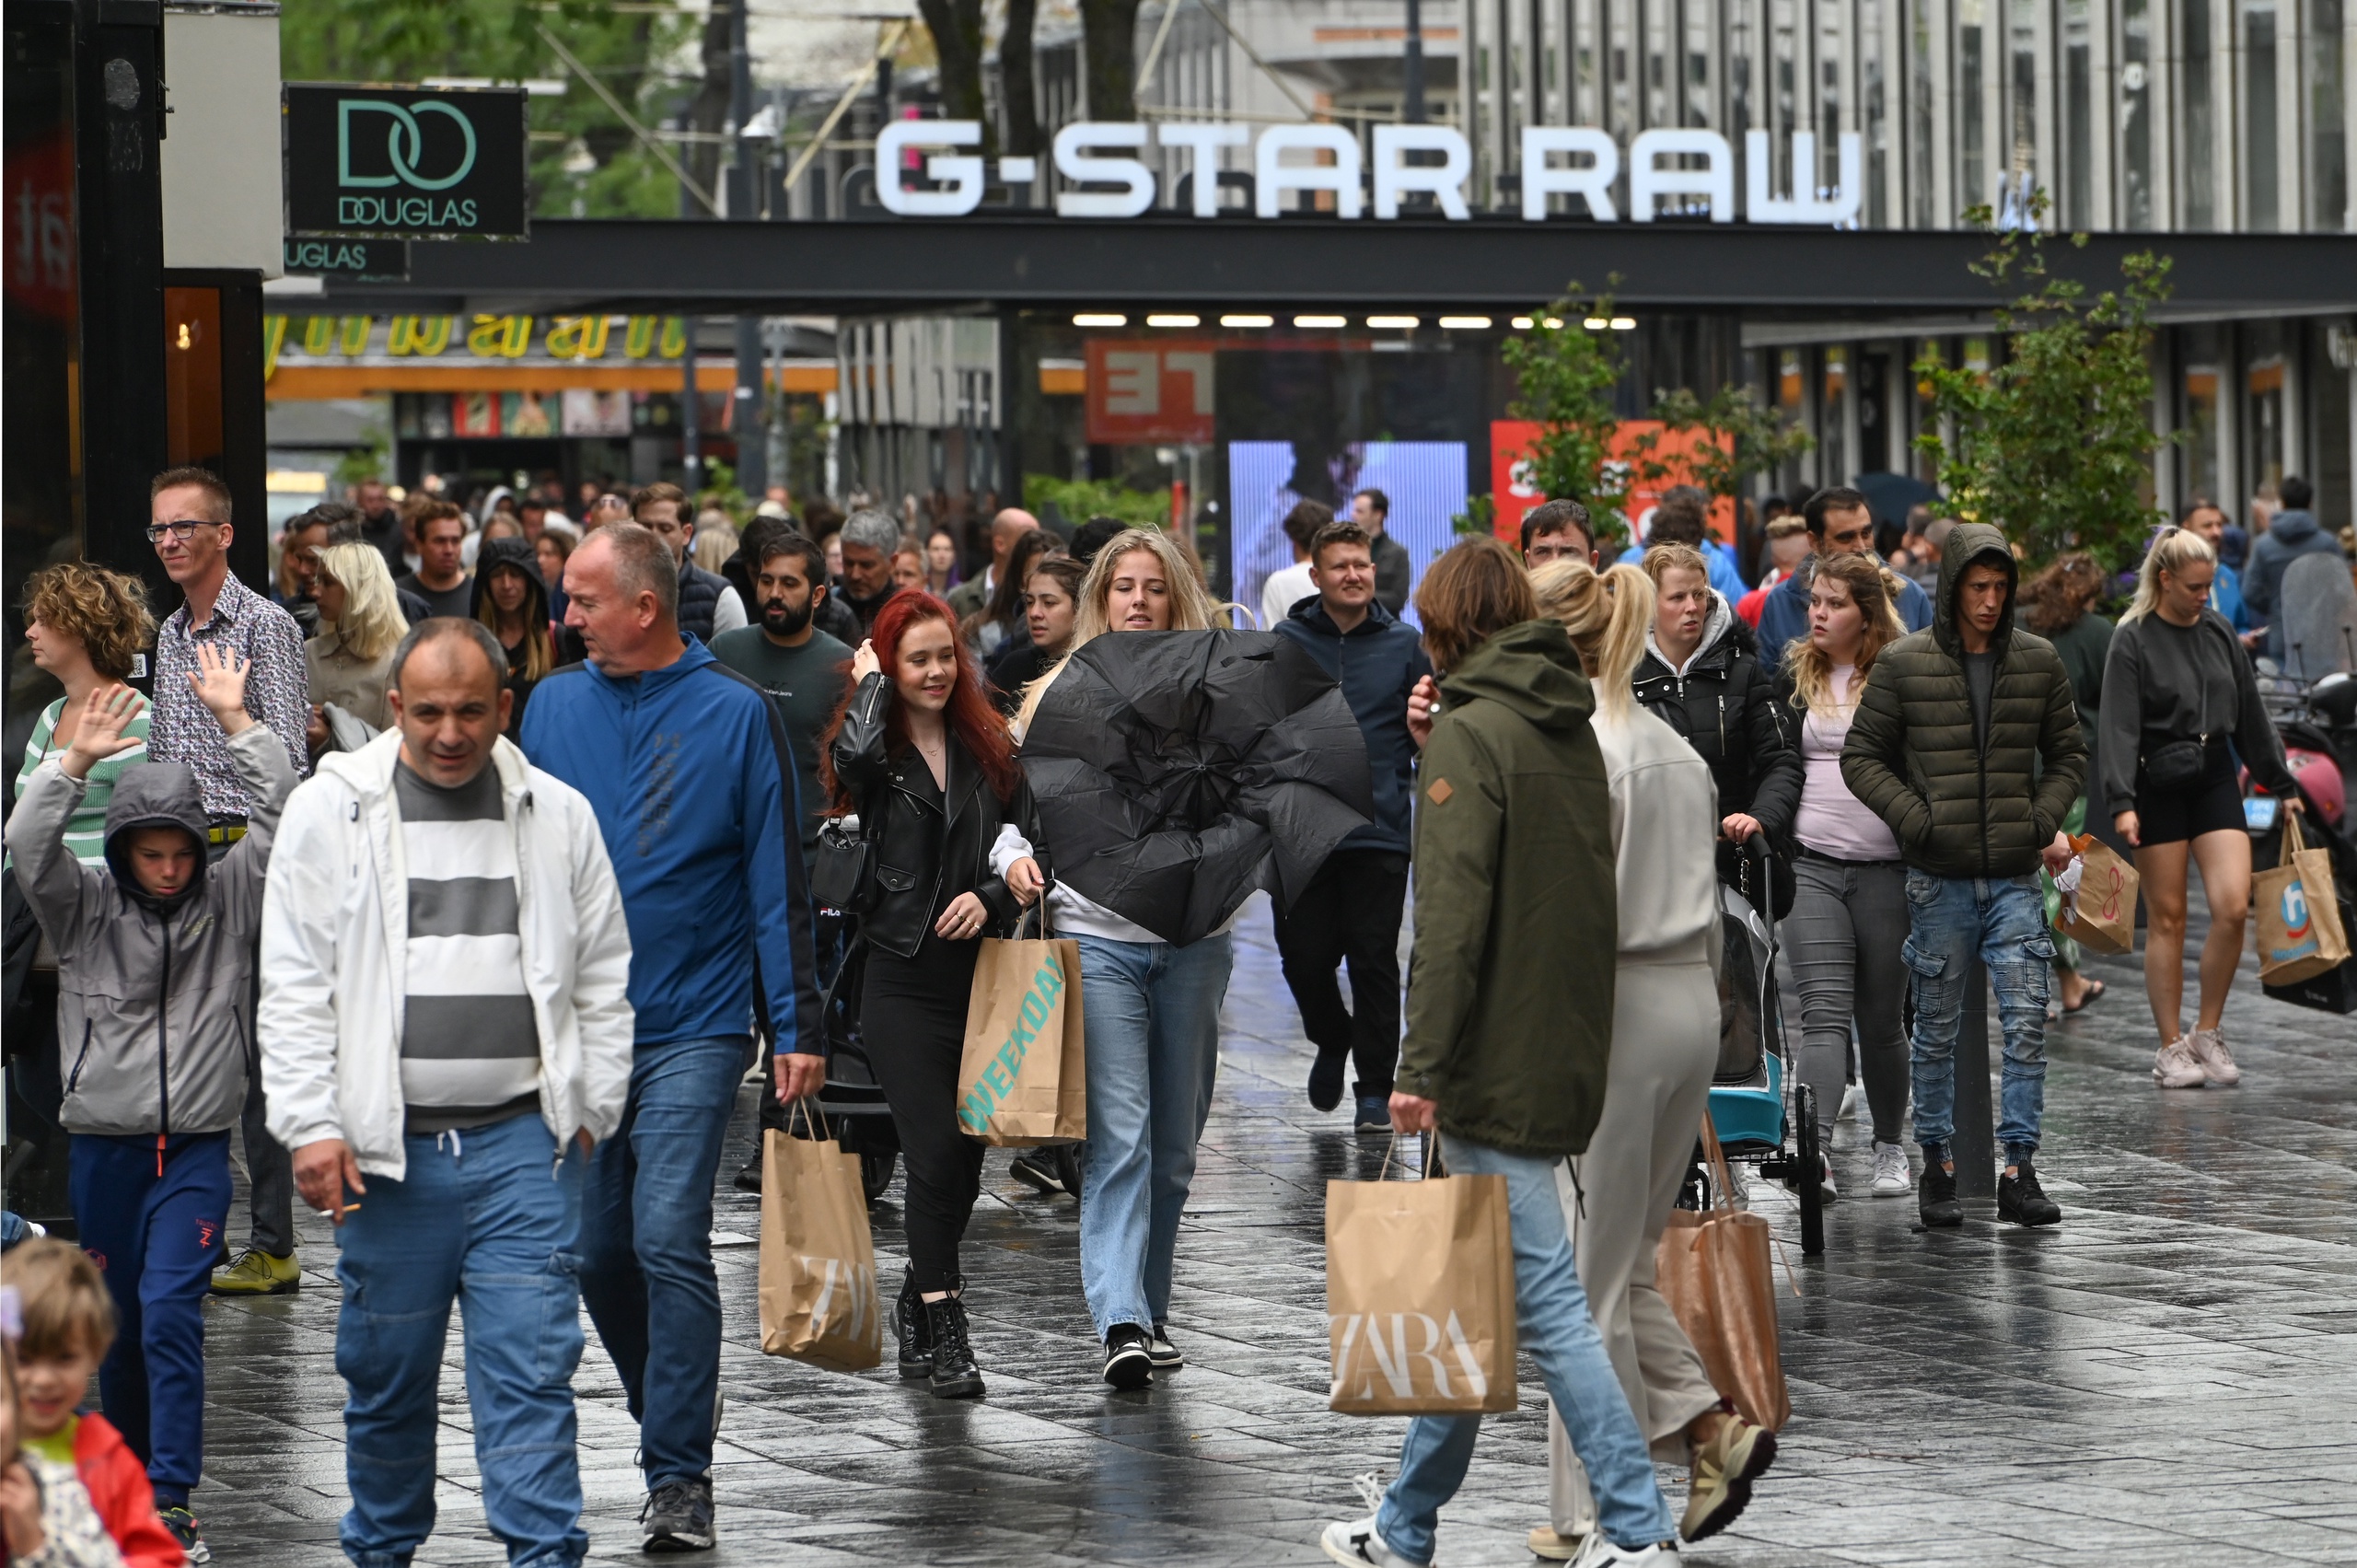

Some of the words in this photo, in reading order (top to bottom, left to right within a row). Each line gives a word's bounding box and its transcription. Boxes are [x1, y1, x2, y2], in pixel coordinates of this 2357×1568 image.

[338, 99, 477, 191] DO
[876, 121, 1470, 219] G-STAR
[1522, 127, 1862, 226] RAW
[284, 241, 366, 270] UGLAS
[339, 196, 477, 227] DOUGLAS
[820, 907, 841, 916] FILA
[958, 948, 1064, 1132] WEEKDAY
[780, 1256, 880, 1351] ZAR
[1329, 1308, 1488, 1400] ZARA
